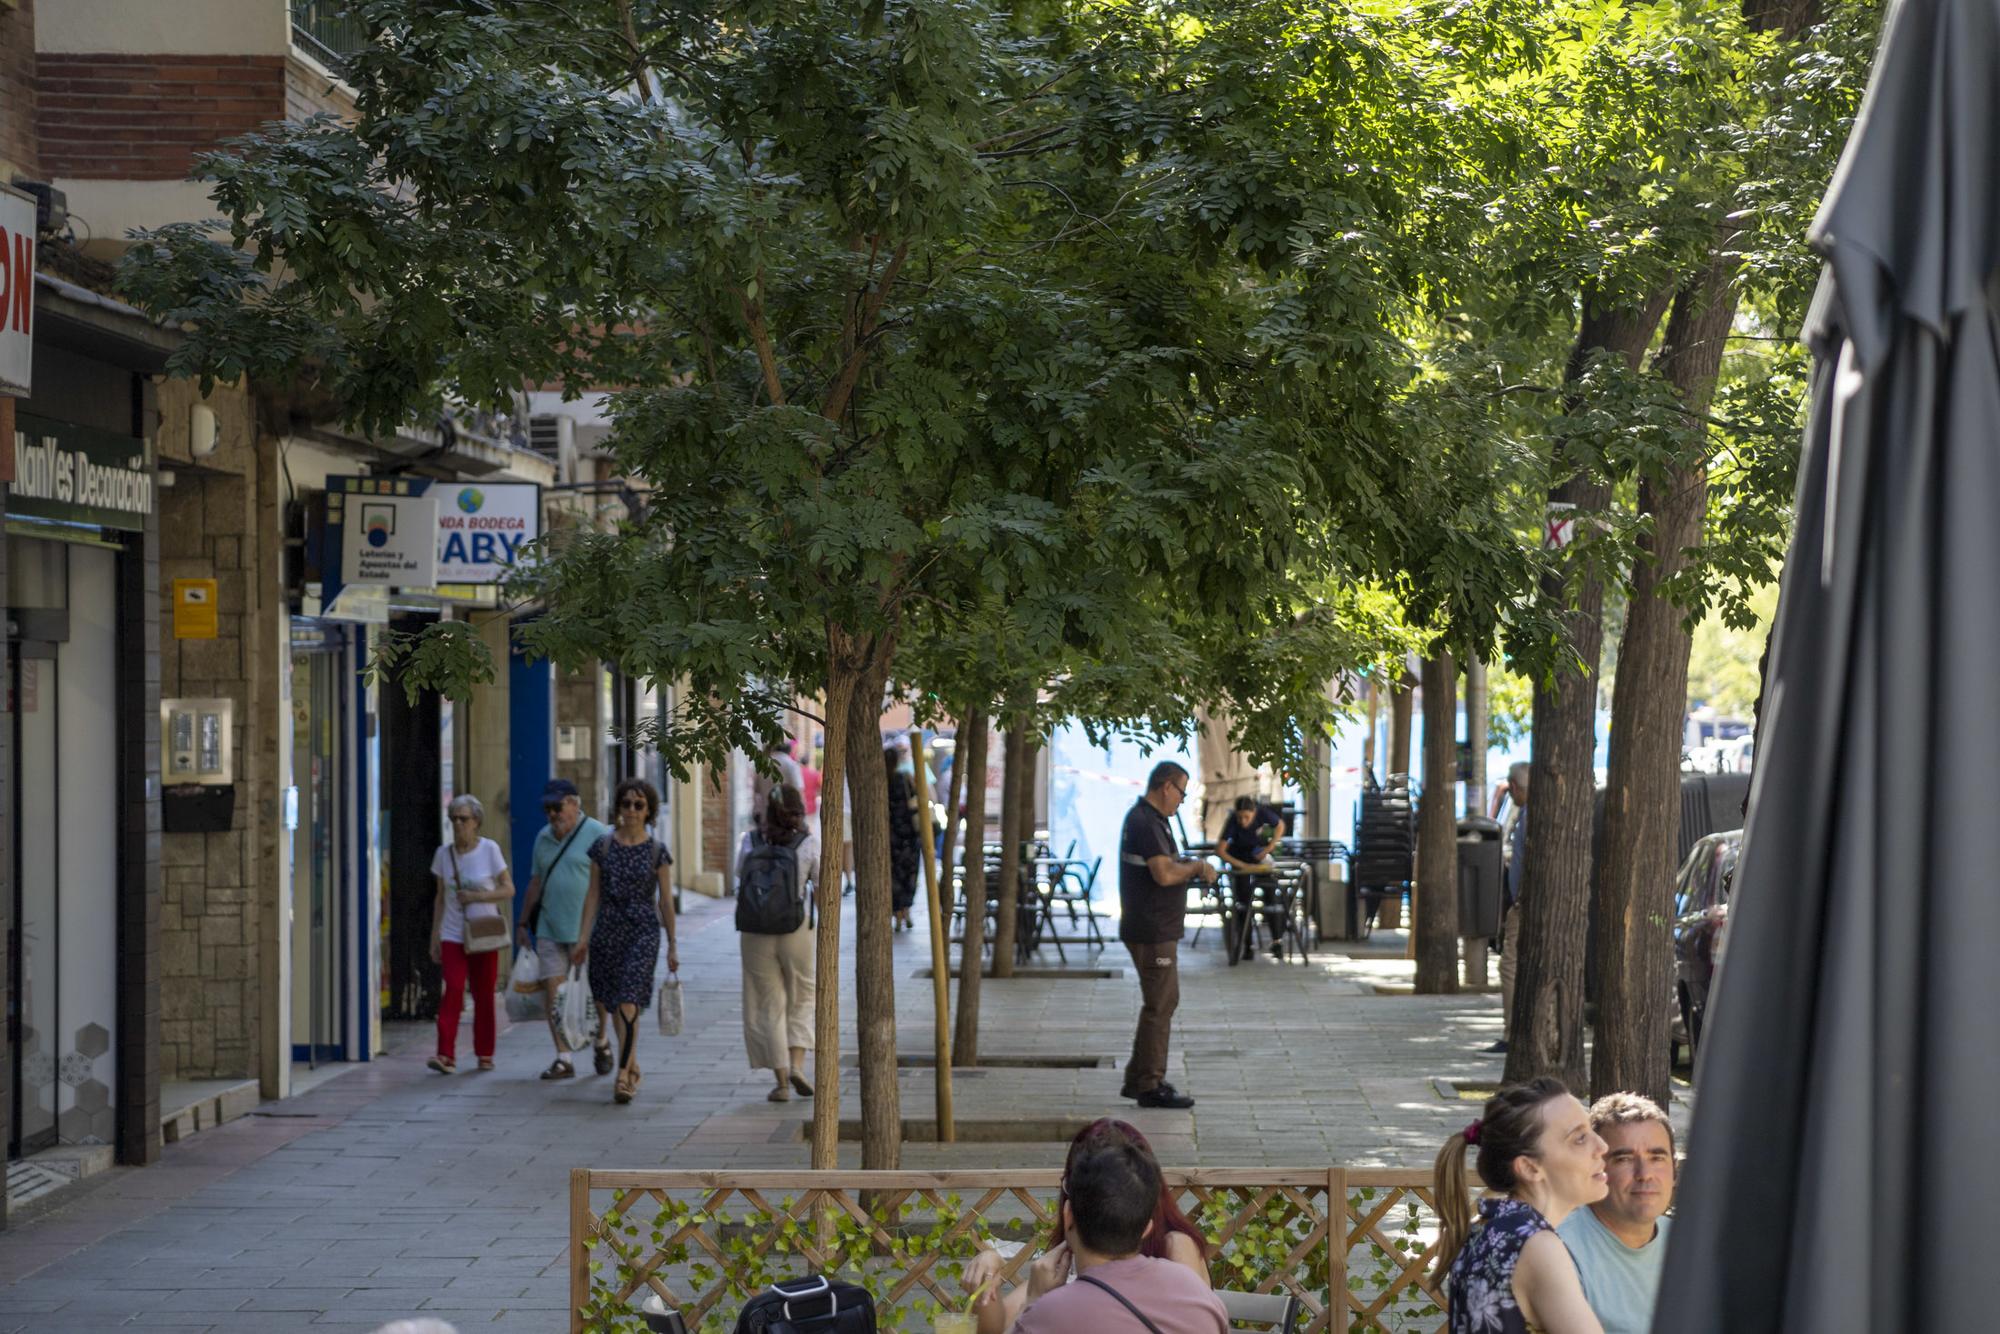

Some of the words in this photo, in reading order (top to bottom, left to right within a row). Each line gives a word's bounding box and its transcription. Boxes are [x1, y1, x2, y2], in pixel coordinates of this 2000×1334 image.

[9, 431, 74, 503] NanYes
[76, 451, 152, 514] Decoración
[468, 517, 525, 529] BODEGA
[437, 532, 524, 564] ABY
